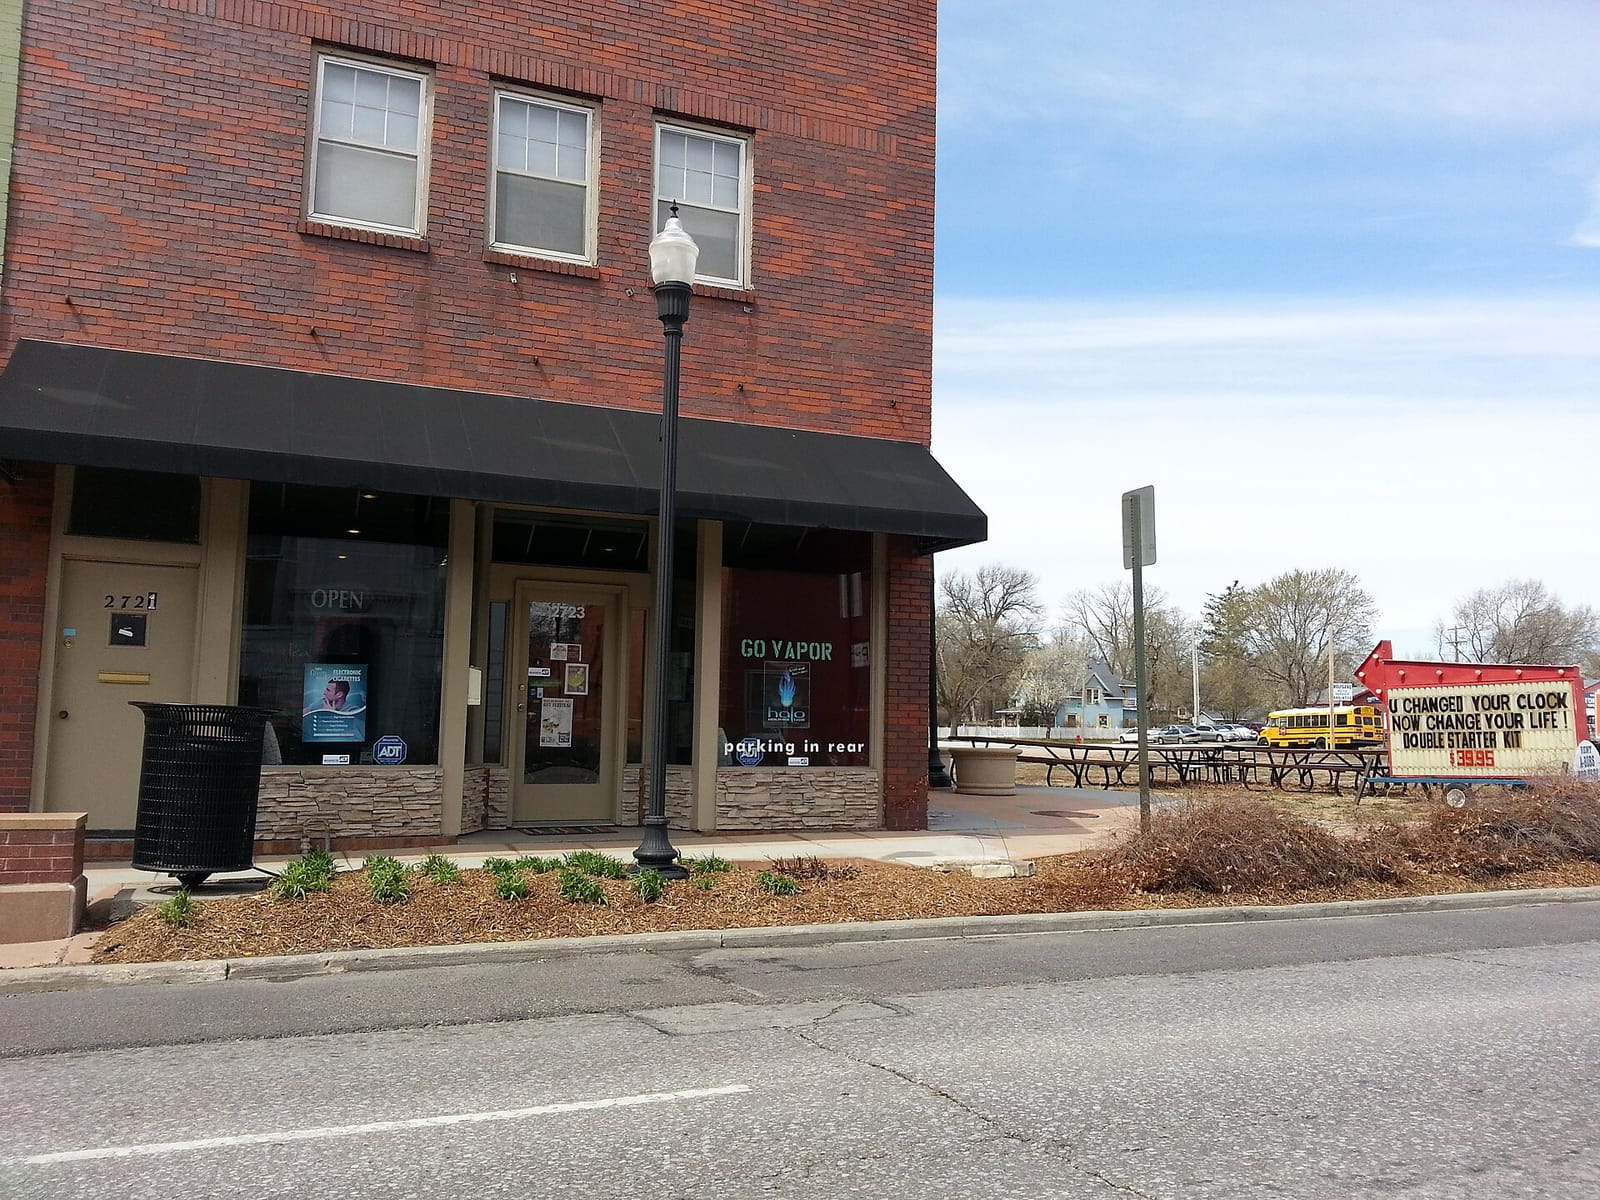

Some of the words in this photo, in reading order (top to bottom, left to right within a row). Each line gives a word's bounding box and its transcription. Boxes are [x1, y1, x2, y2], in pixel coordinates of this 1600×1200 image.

[104, 592, 158, 610] 2721
[311, 589, 363, 609] OPEN
[551, 605, 585, 619] 2723
[741, 639, 765, 658] GO
[772, 640, 833, 661] VAPOR
[1389, 699, 1398, 713] U
[1403, 696, 1463, 713] CHANGED
[1471, 694, 1511, 711] YOUR
[1516, 692, 1568, 709] CLOCK
[768, 707, 806, 723] halo
[1392, 715, 1421, 731] NOW
[1426, 713, 1482, 730] CHANGE
[1485, 712, 1524, 729] YOUR
[724, 739, 795, 756] parking
[804, 739, 820, 753] in
[828, 742, 864, 753] rear
[1403, 732, 1444, 749] DOUBLE
[1448, 731, 1497, 748] STARTER
[1503, 731, 1521, 748] KIT
[378, 746, 401, 757] ADT
[1449, 750, 1495, 767] $39.95
